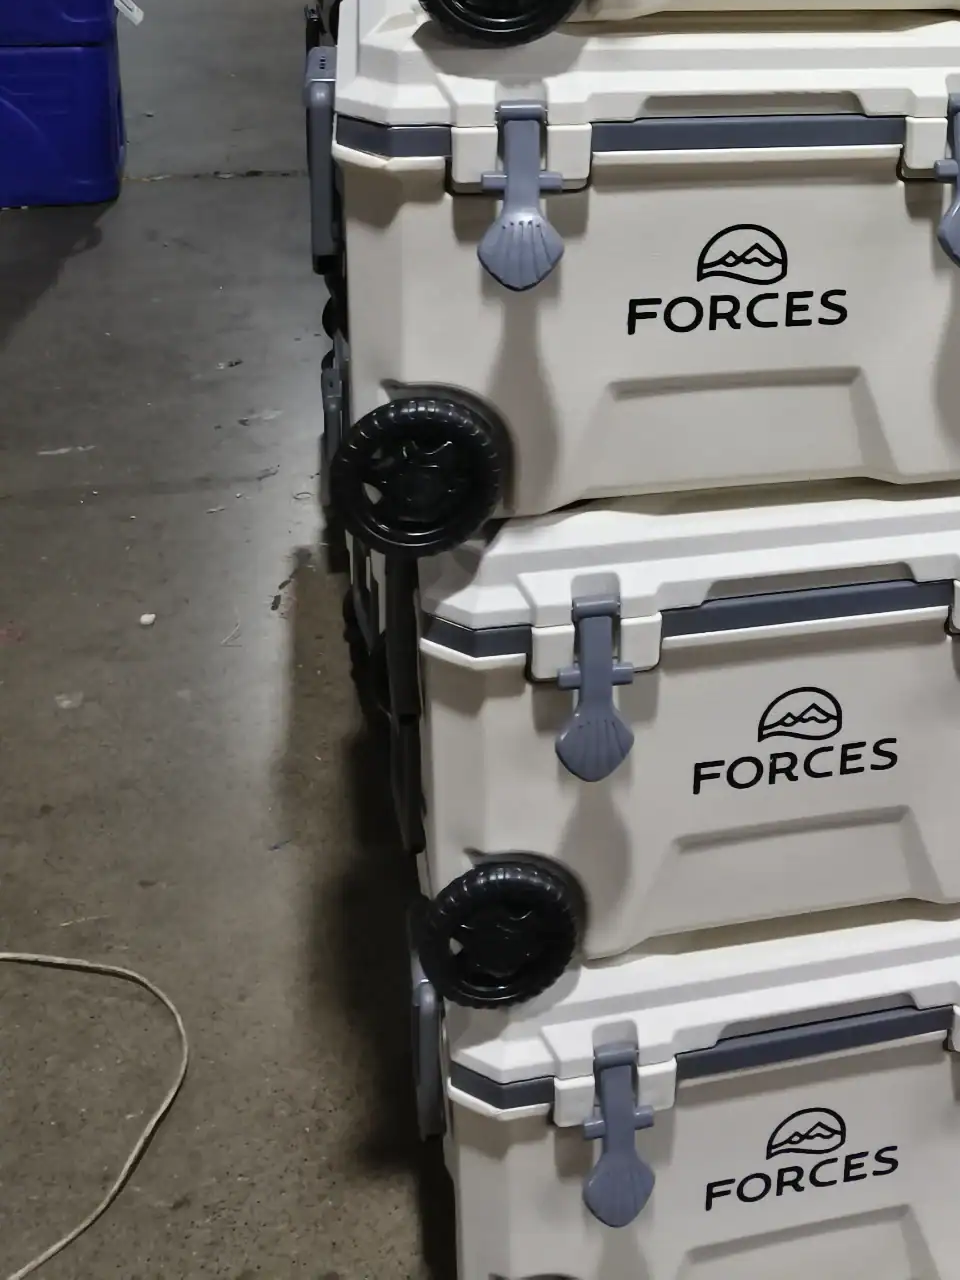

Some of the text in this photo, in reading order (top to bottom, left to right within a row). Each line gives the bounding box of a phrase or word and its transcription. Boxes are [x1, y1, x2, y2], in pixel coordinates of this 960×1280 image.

[626, 288, 848, 336] FORCES
[692, 737, 898, 795] FORCES
[705, 1145, 899, 1212] FORCES
